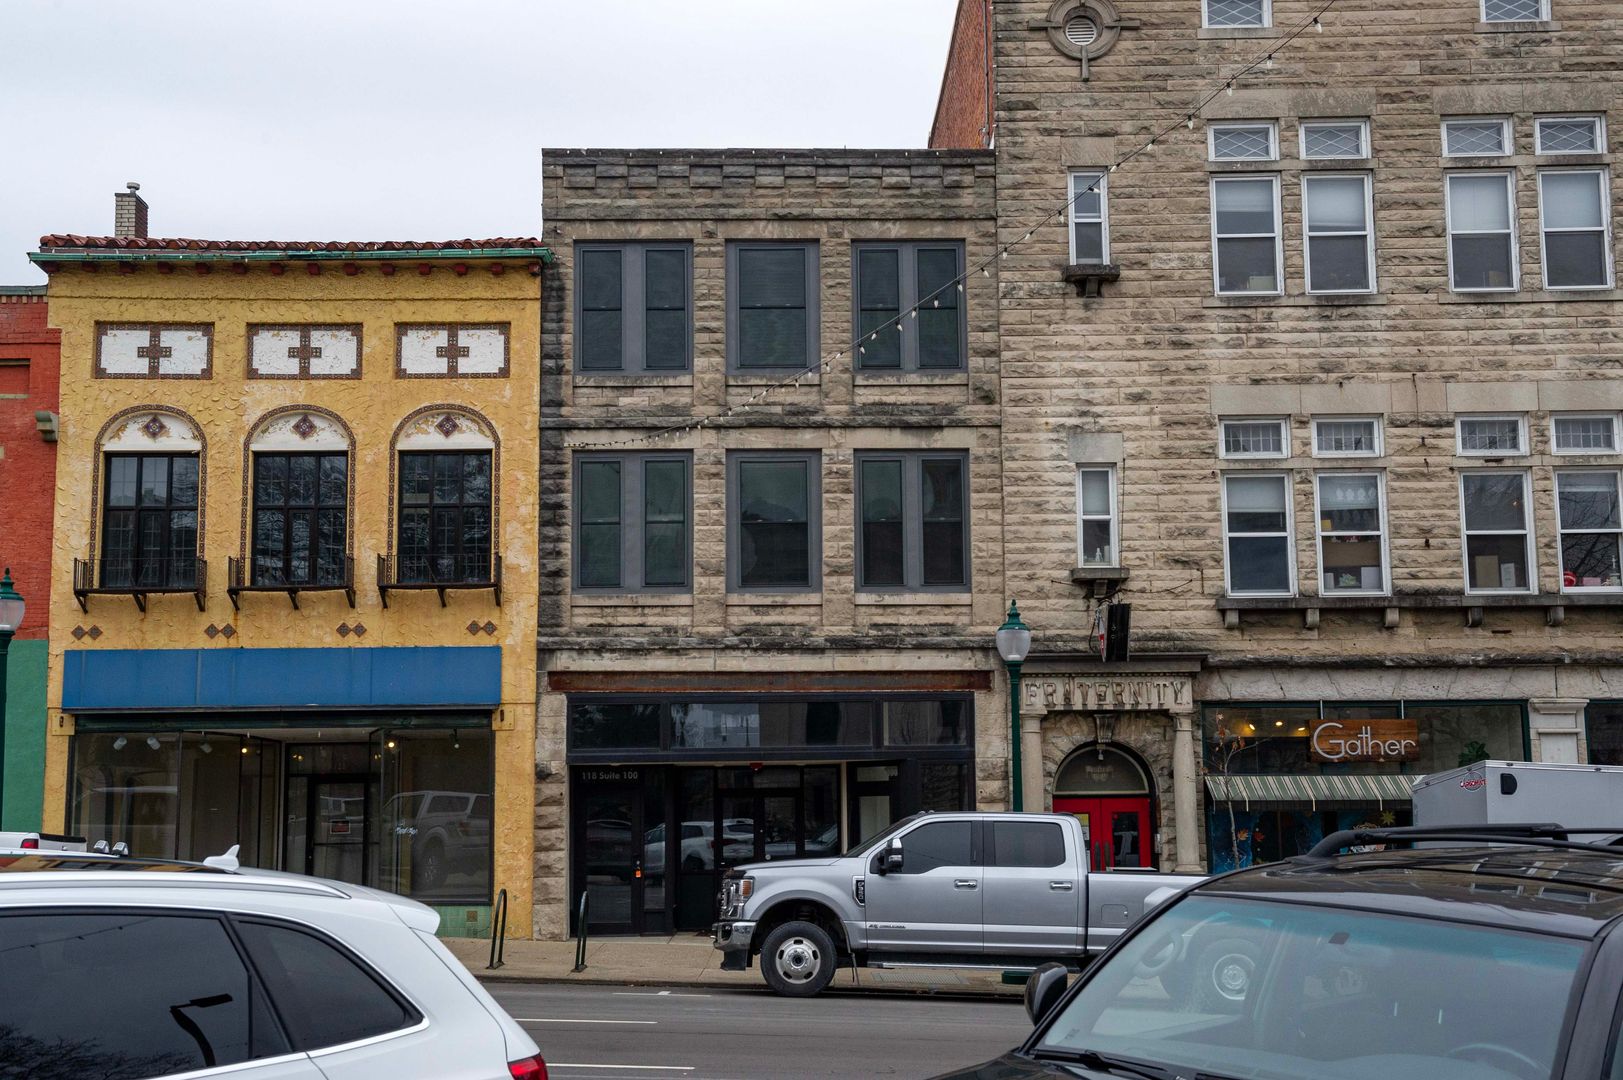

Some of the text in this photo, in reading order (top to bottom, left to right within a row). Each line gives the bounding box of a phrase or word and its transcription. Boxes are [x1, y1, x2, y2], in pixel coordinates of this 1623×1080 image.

[1313, 722, 1416, 759] Gather
[582, 771, 638, 780] 118 Suite 100
